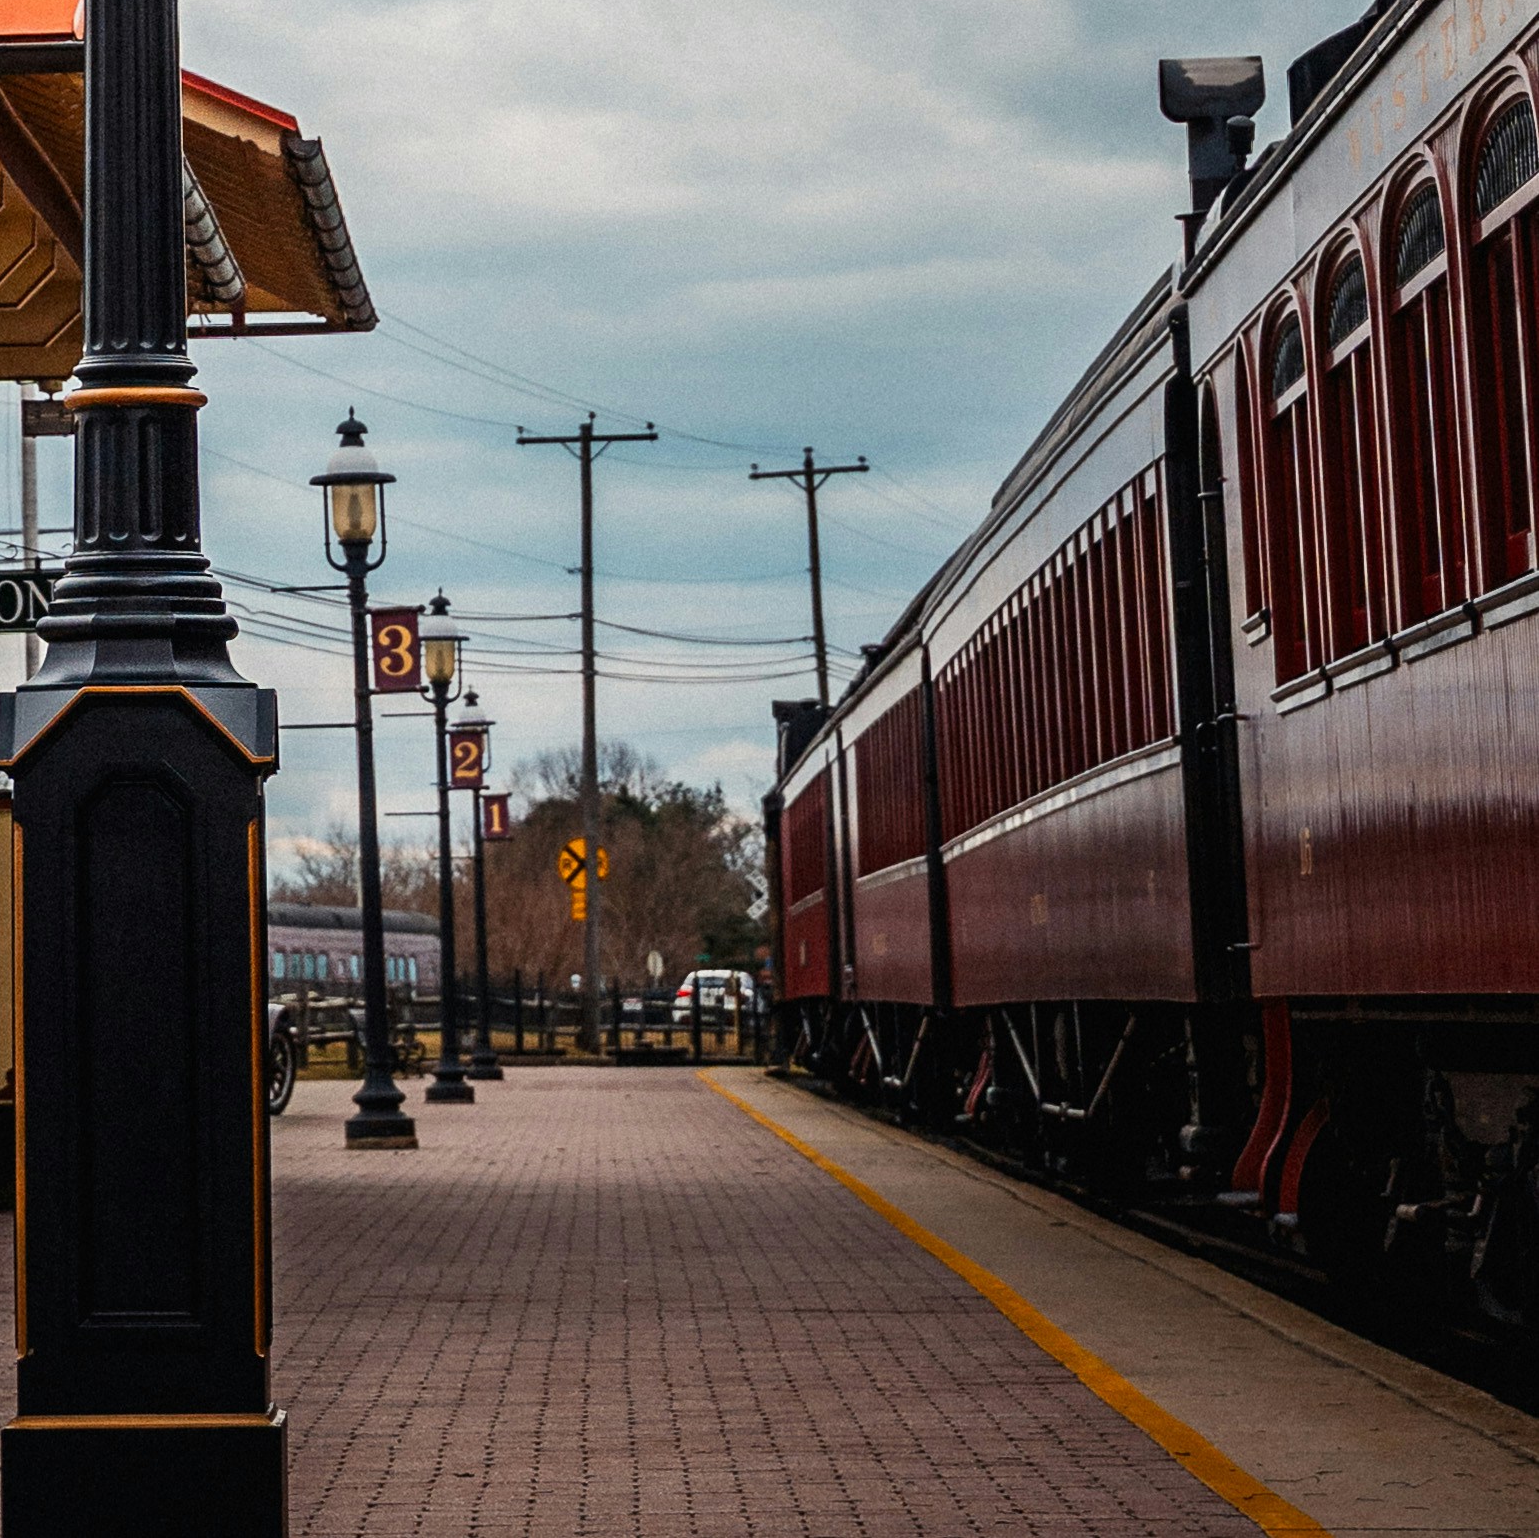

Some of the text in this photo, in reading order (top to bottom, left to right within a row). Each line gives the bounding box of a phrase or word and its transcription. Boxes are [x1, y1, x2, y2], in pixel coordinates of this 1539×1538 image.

[378, 624, 414, 676] 3
[453, 741, 479, 778] 2
[489, 803, 504, 833] 1
